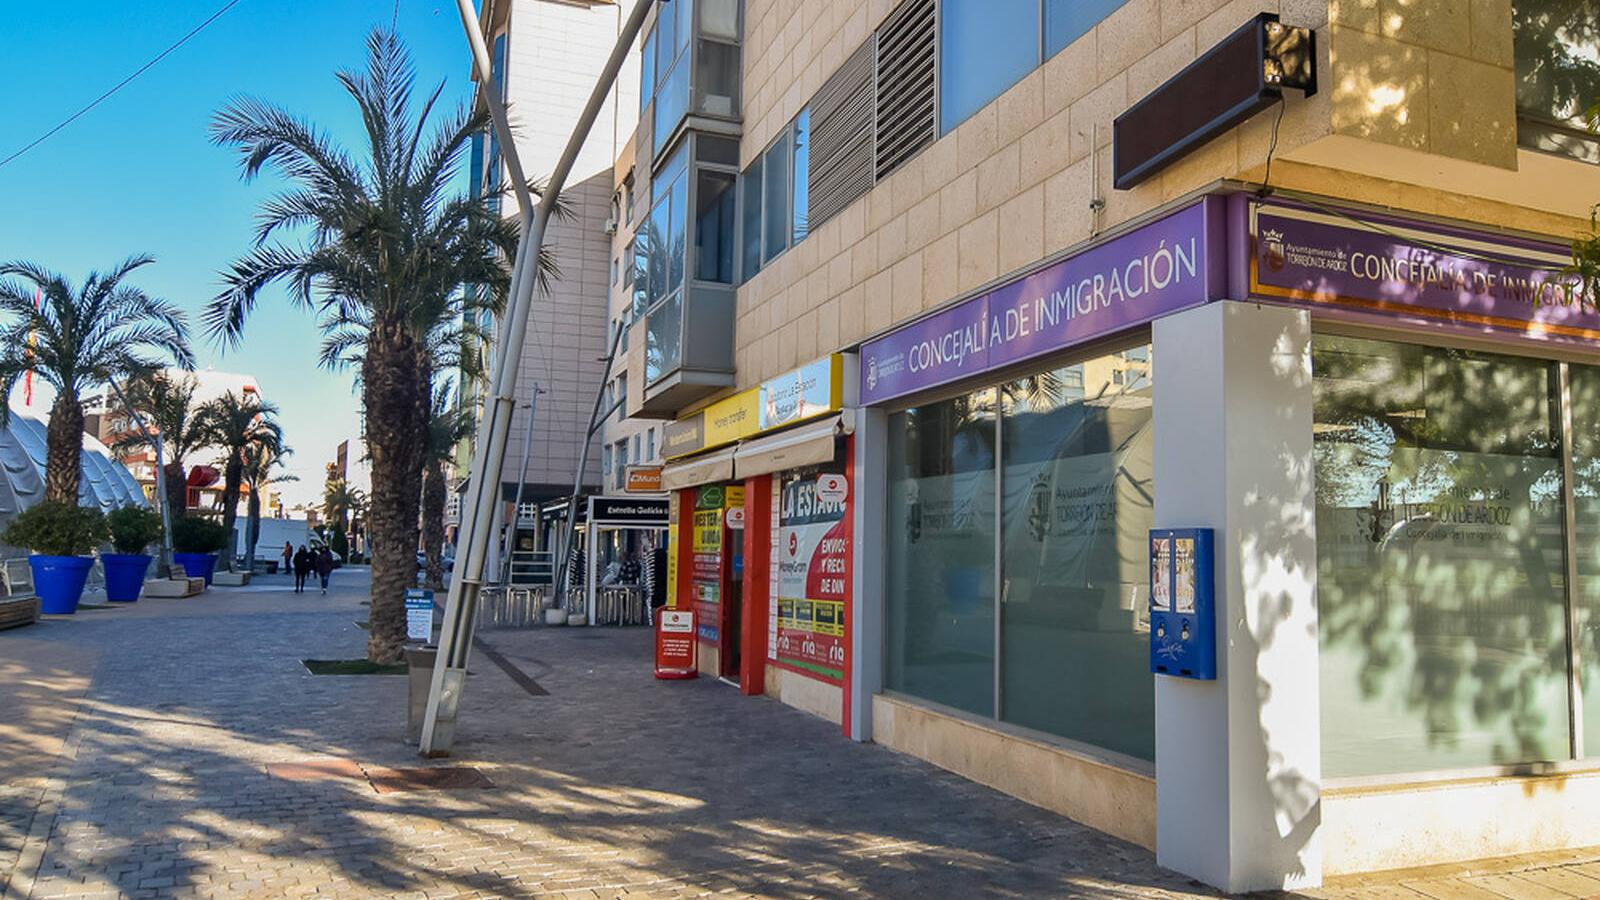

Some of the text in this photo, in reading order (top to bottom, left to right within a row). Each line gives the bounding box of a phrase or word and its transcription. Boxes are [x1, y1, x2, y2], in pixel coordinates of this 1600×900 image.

[1286, 243, 1347, 260] Ayuntamiento de
[1350, 252, 1466, 292] CONCEJALÍA
[1473, 271, 1497, 297] DE
[909, 238, 1196, 373] CONCEJALÍA DE INMIGRACIÓN
[607, 506, 636, 514] Estrella
[636, 506, 663, 514] Galicia
[781, 487, 794, 519] LA
[695, 511, 721, 528] WESTER
[1474, 505, 1511, 526] ARDOZ
[821, 579, 831, 593] DE
[802, 635, 815, 655] ria
[829, 639, 844, 661] ria
